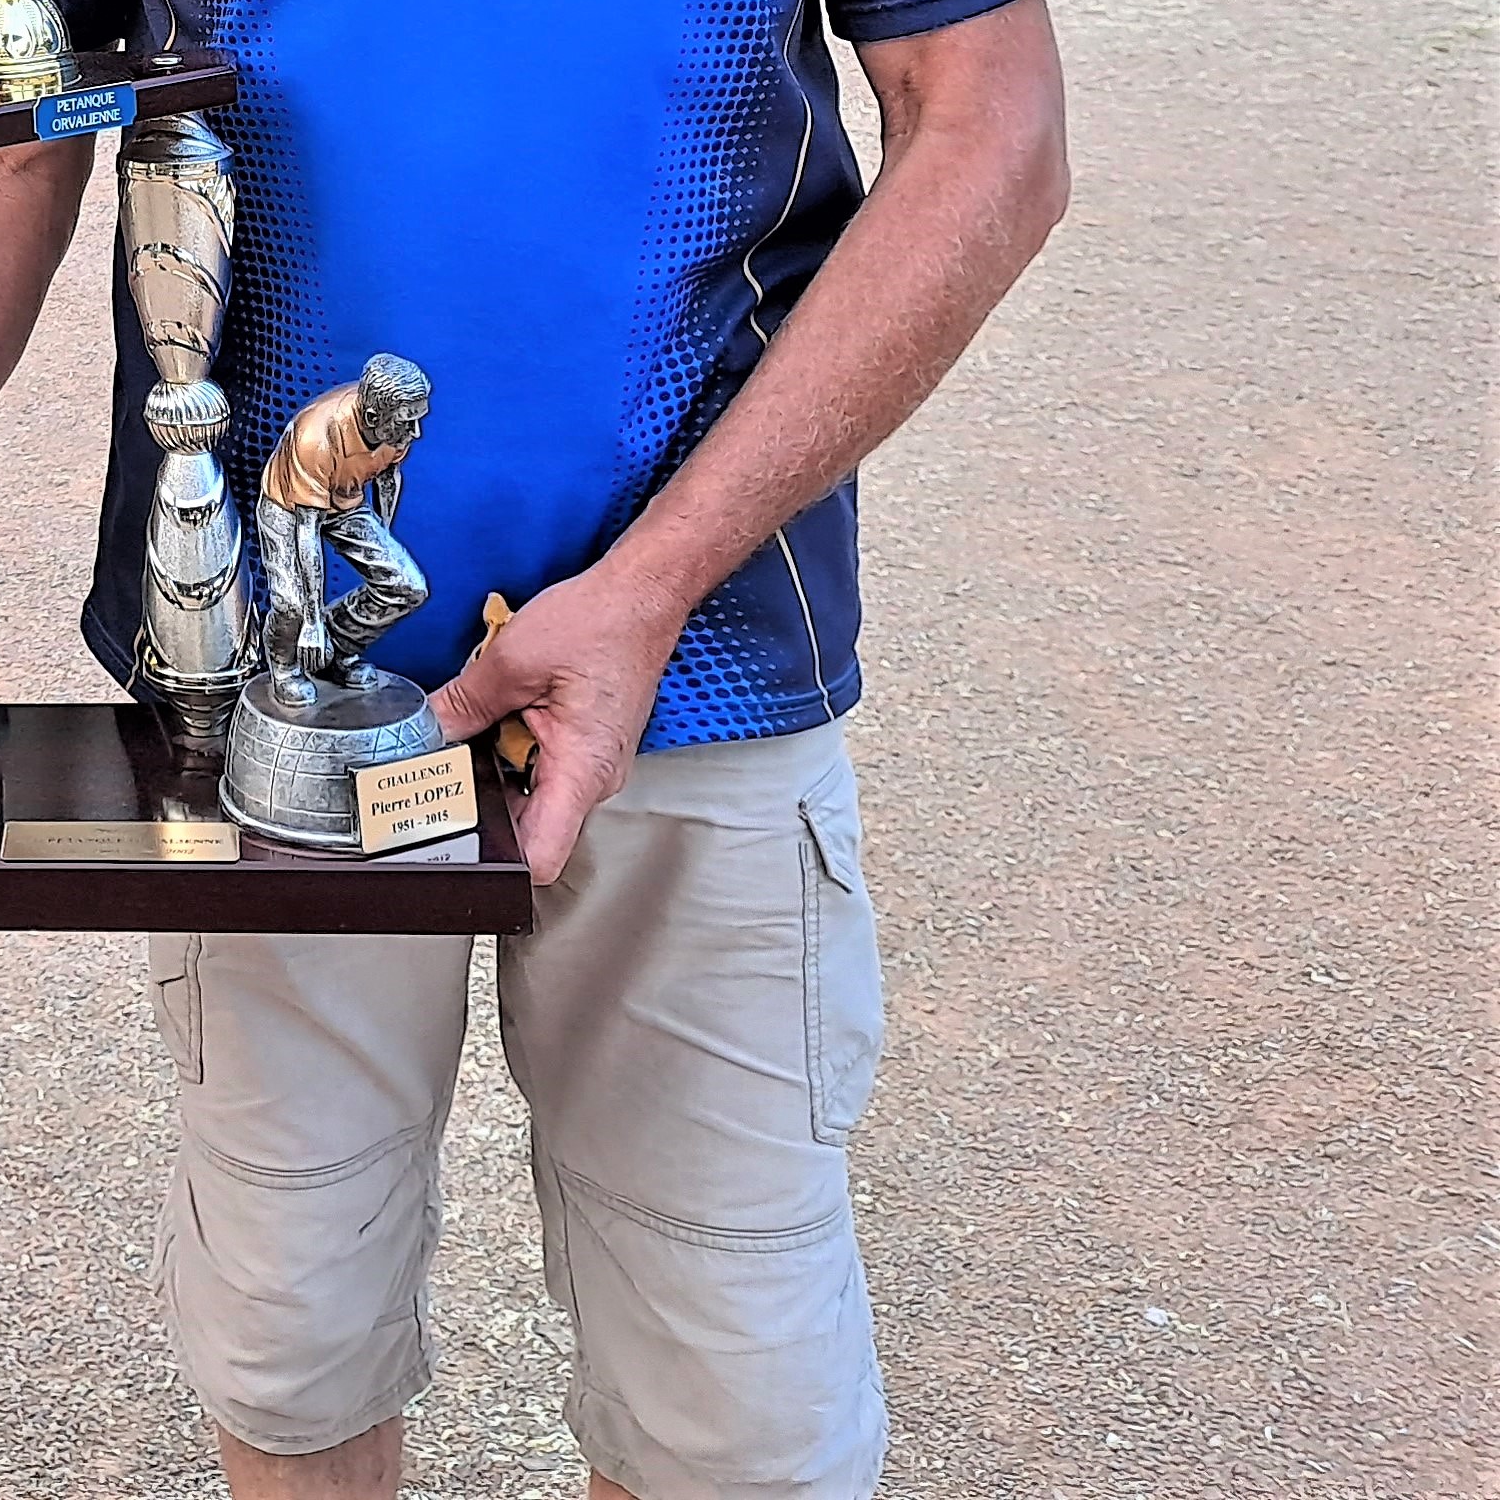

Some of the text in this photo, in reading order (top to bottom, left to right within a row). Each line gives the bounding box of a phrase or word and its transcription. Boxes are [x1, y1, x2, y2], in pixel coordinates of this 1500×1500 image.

[56, 91, 116, 113] PETANQUE
[51, 108, 122, 132] ORVALIENNE
[377, 761, 453, 790] CHALLENGE
[371, 780, 464, 817] Pierre LOPEZ
[391, 818, 415, 834] 1951
[425, 809, 450, 826] 2015
